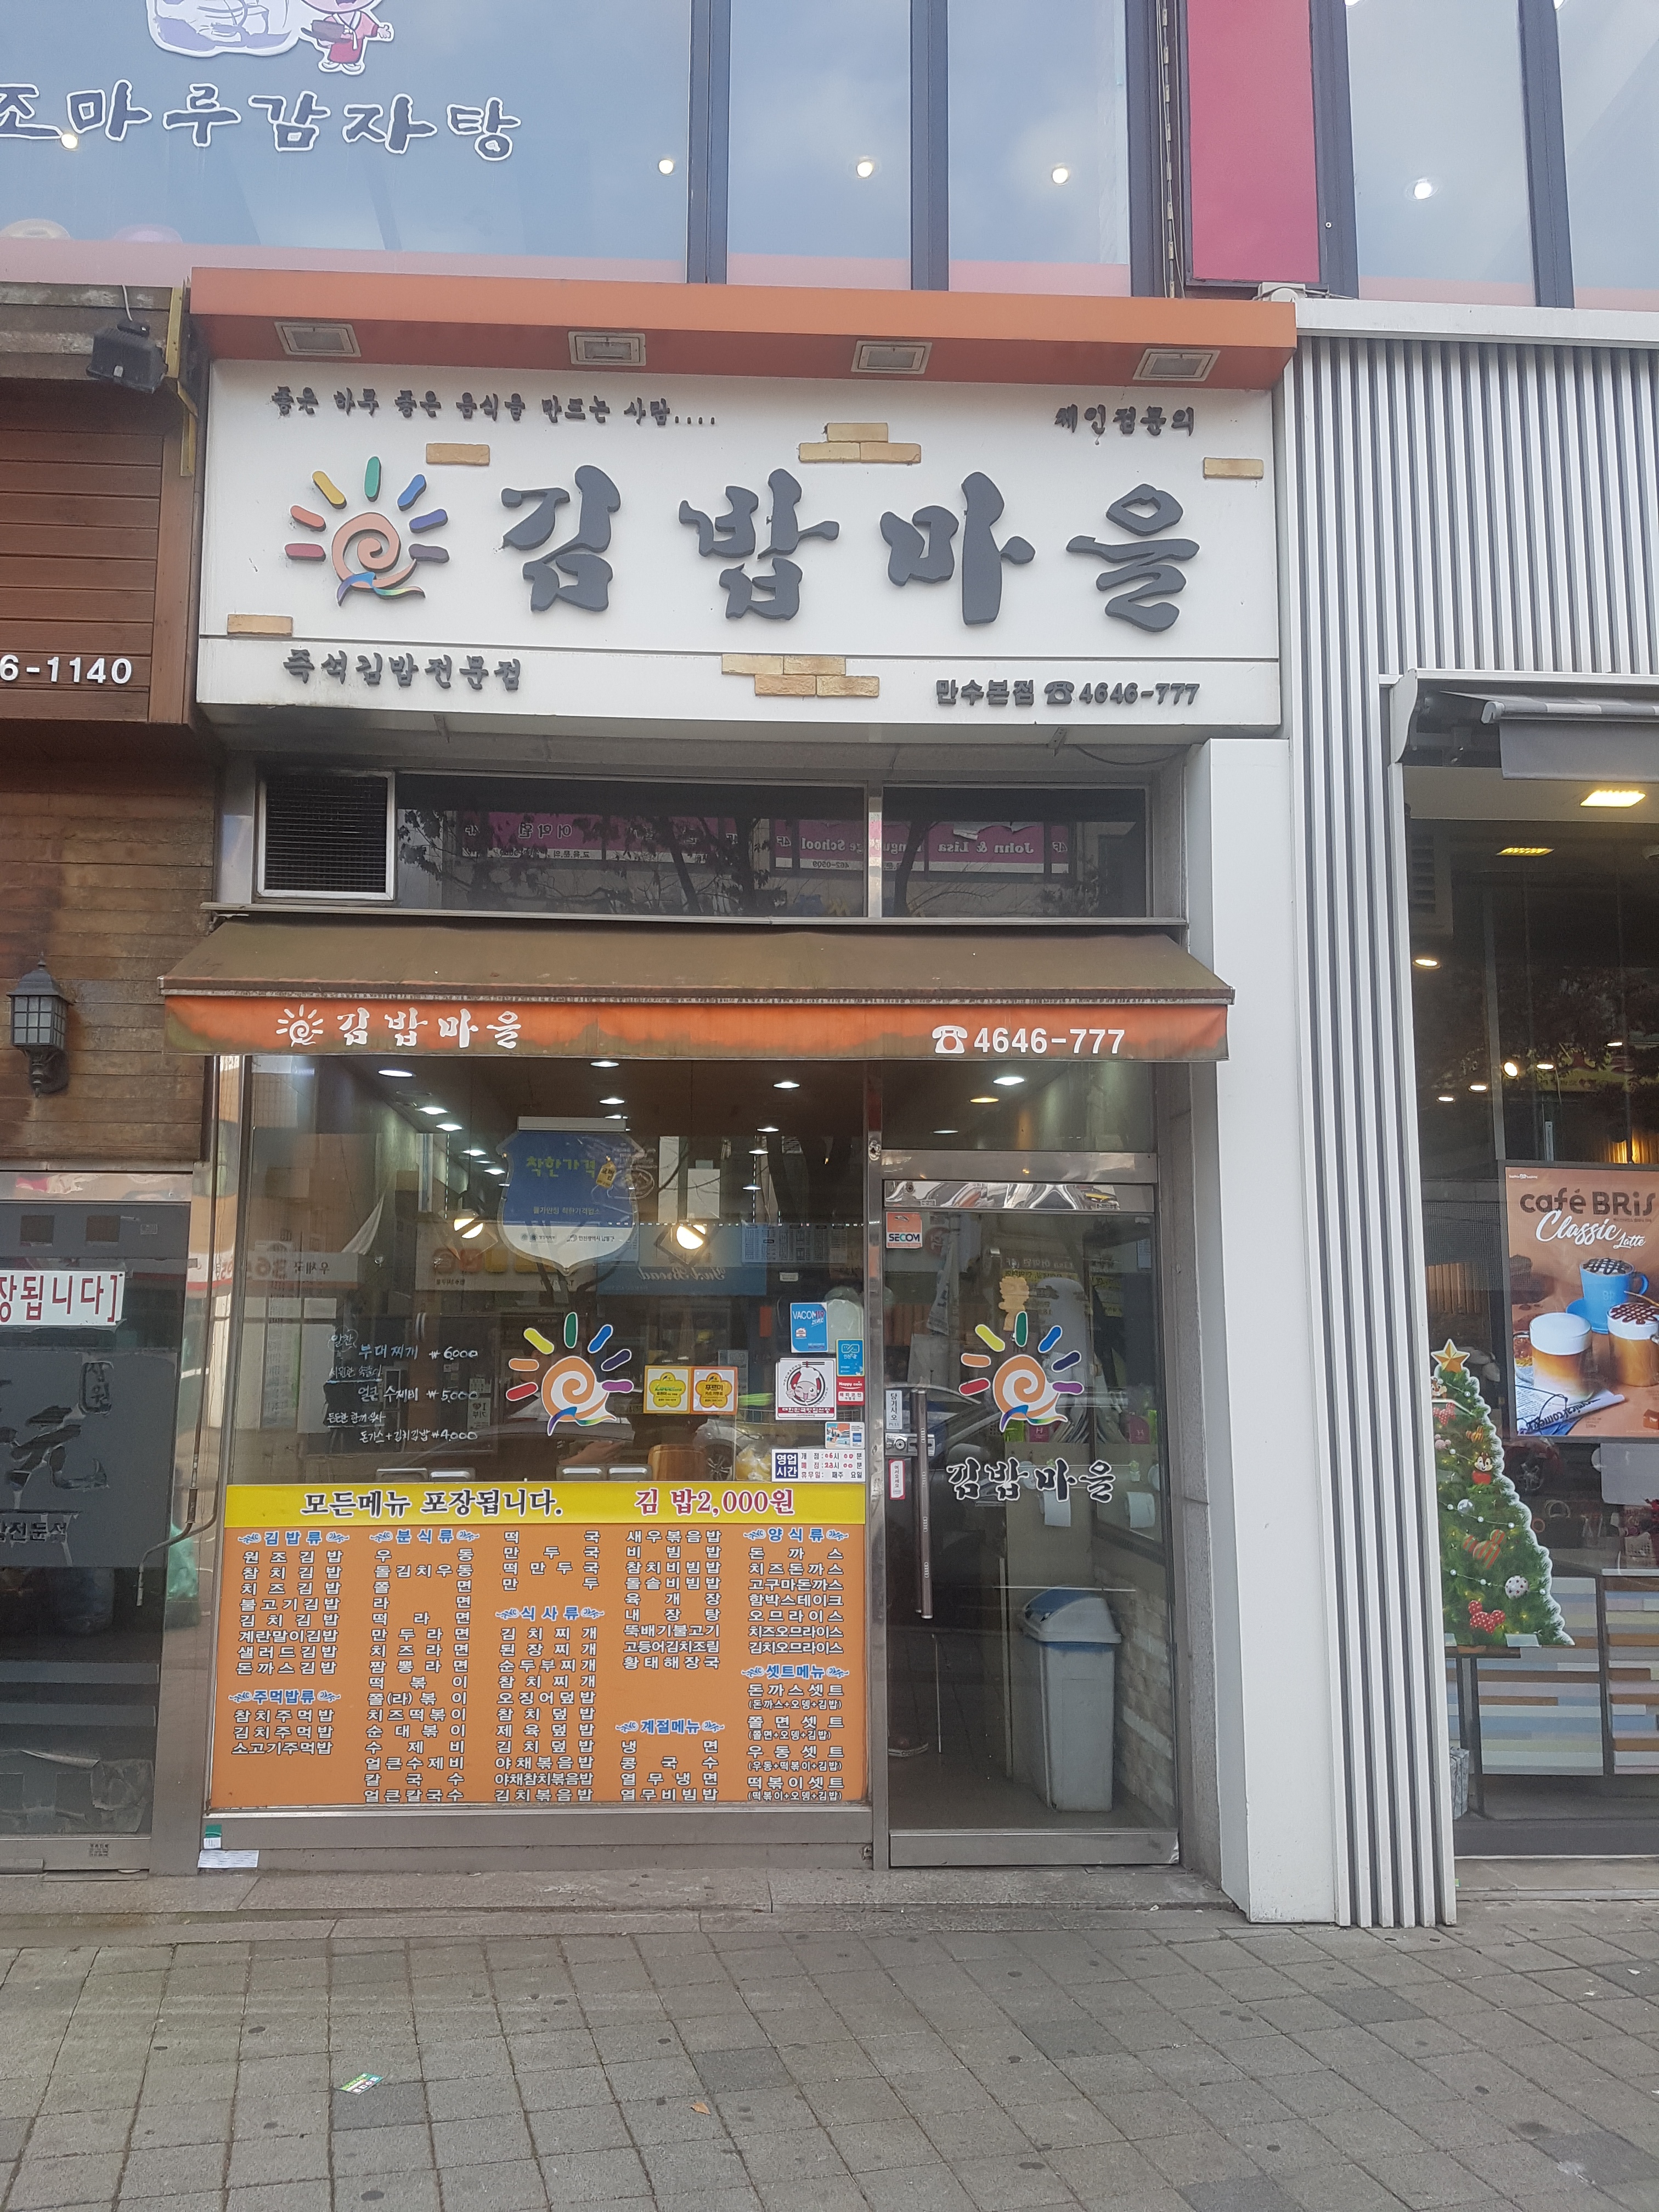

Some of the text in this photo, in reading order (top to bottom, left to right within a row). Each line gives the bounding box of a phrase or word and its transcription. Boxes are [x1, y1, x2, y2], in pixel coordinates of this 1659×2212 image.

[0, 80, 521, 161] 조마루감자탕
[271, 386, 318, 416] 좋은
[394, 390, 441, 418] 좋은
[455, 392, 525, 421] 음식을
[541, 394, 610, 424] 만드는
[1054, 404, 1194, 436] 체인점문의
[500, 464, 1200, 633] 김밥마을
[0, 654, 133, 684] 6-1140
[283, 649, 521, 691] 즉석김밥전문점
[936, 679, 1200, 706] 만수본점 4646-777
[336, 1007, 522, 1048] 김밥마을
[974, 1027, 1125, 1054] 4646-777
[526, 1155, 596, 1179] 착한가격
[1520, 1187, 1587, 1214] café
[1536, 1209, 1646, 1249] Classic Latte
[889, 1233, 920, 1242] SECOM
[358, 1344, 419, 1360] 부대찌개
[358, 1385, 379, 1402] 얼큰
[383, 1385, 419, 1403] 수제비
[777, 1454, 797, 1465] 영업
[776, 1466, 797, 1478] 시간
[946, 1456, 1116, 1504] 김밥마을
[301, 1489, 411, 1517] 모든메뉴
[420, 1488, 563, 1517] 포장됩니다.
[748, 1578, 844, 1592] 고구마돈까스
[748, 1593, 843, 1607] 함박스테이크
[239, 1629, 338, 1643] 계란말이김밥
[624, 1624, 720, 1638] 뚝배기불고기
[749, 1626, 843, 1639] 치즈오므라이스
[623, 1640, 720, 1654] 고등어김치조림
[748, 1641, 843, 1655] 김치오므라이스
[766, 1664, 825, 1680] 셋트메뉴
[253, 1689, 315, 1705] 주먹밥류
[640, 1719, 701, 1735] 계절메뉴
[232, 1741, 332, 1755] 소고기주먹밥
[495, 1773, 593, 1786] 야채참치볶음밥
